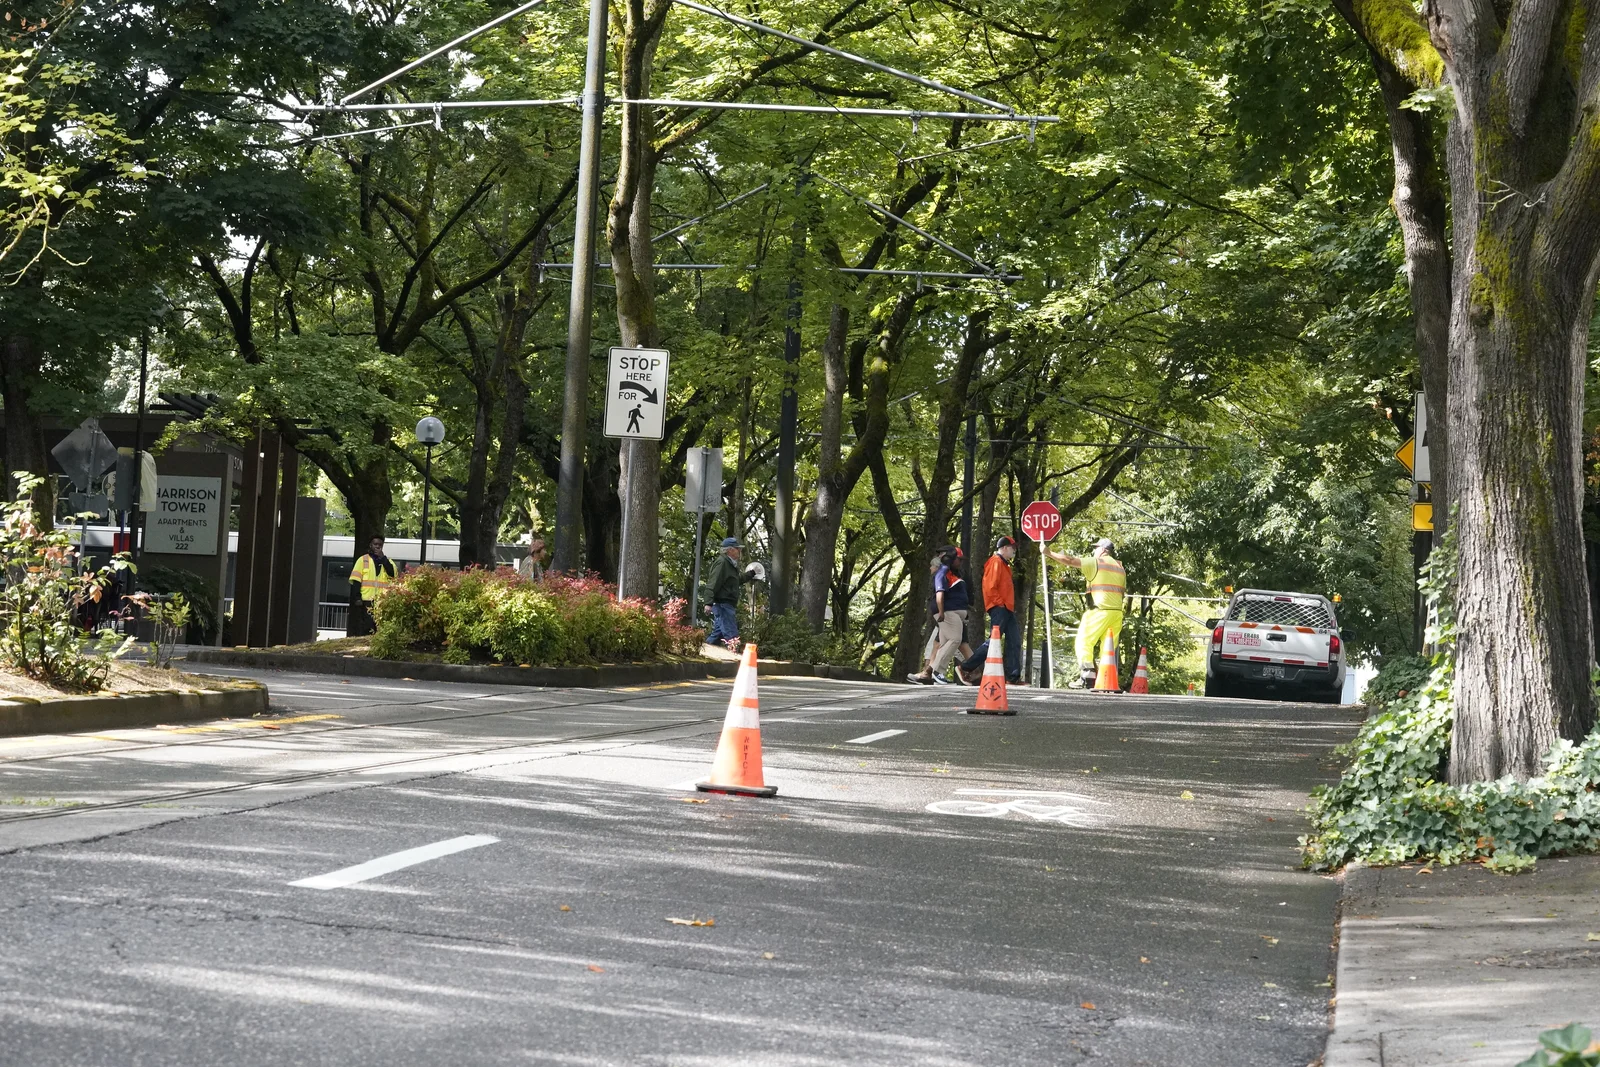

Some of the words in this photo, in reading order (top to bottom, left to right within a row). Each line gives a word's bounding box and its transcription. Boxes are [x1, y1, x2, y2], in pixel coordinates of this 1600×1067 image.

[619, 357, 661, 371] STOP
[626, 372, 652, 382] HERE
[618, 391, 637, 400] FOR
[160, 501, 206, 513] TOWER
[157, 518, 208, 527] APARTMENTS
[1023, 513, 1060, 529] STOP
[179, 526, 185, 534] &
[168, 534, 195, 542] VILLAS
[175, 543, 189, 551] 222
